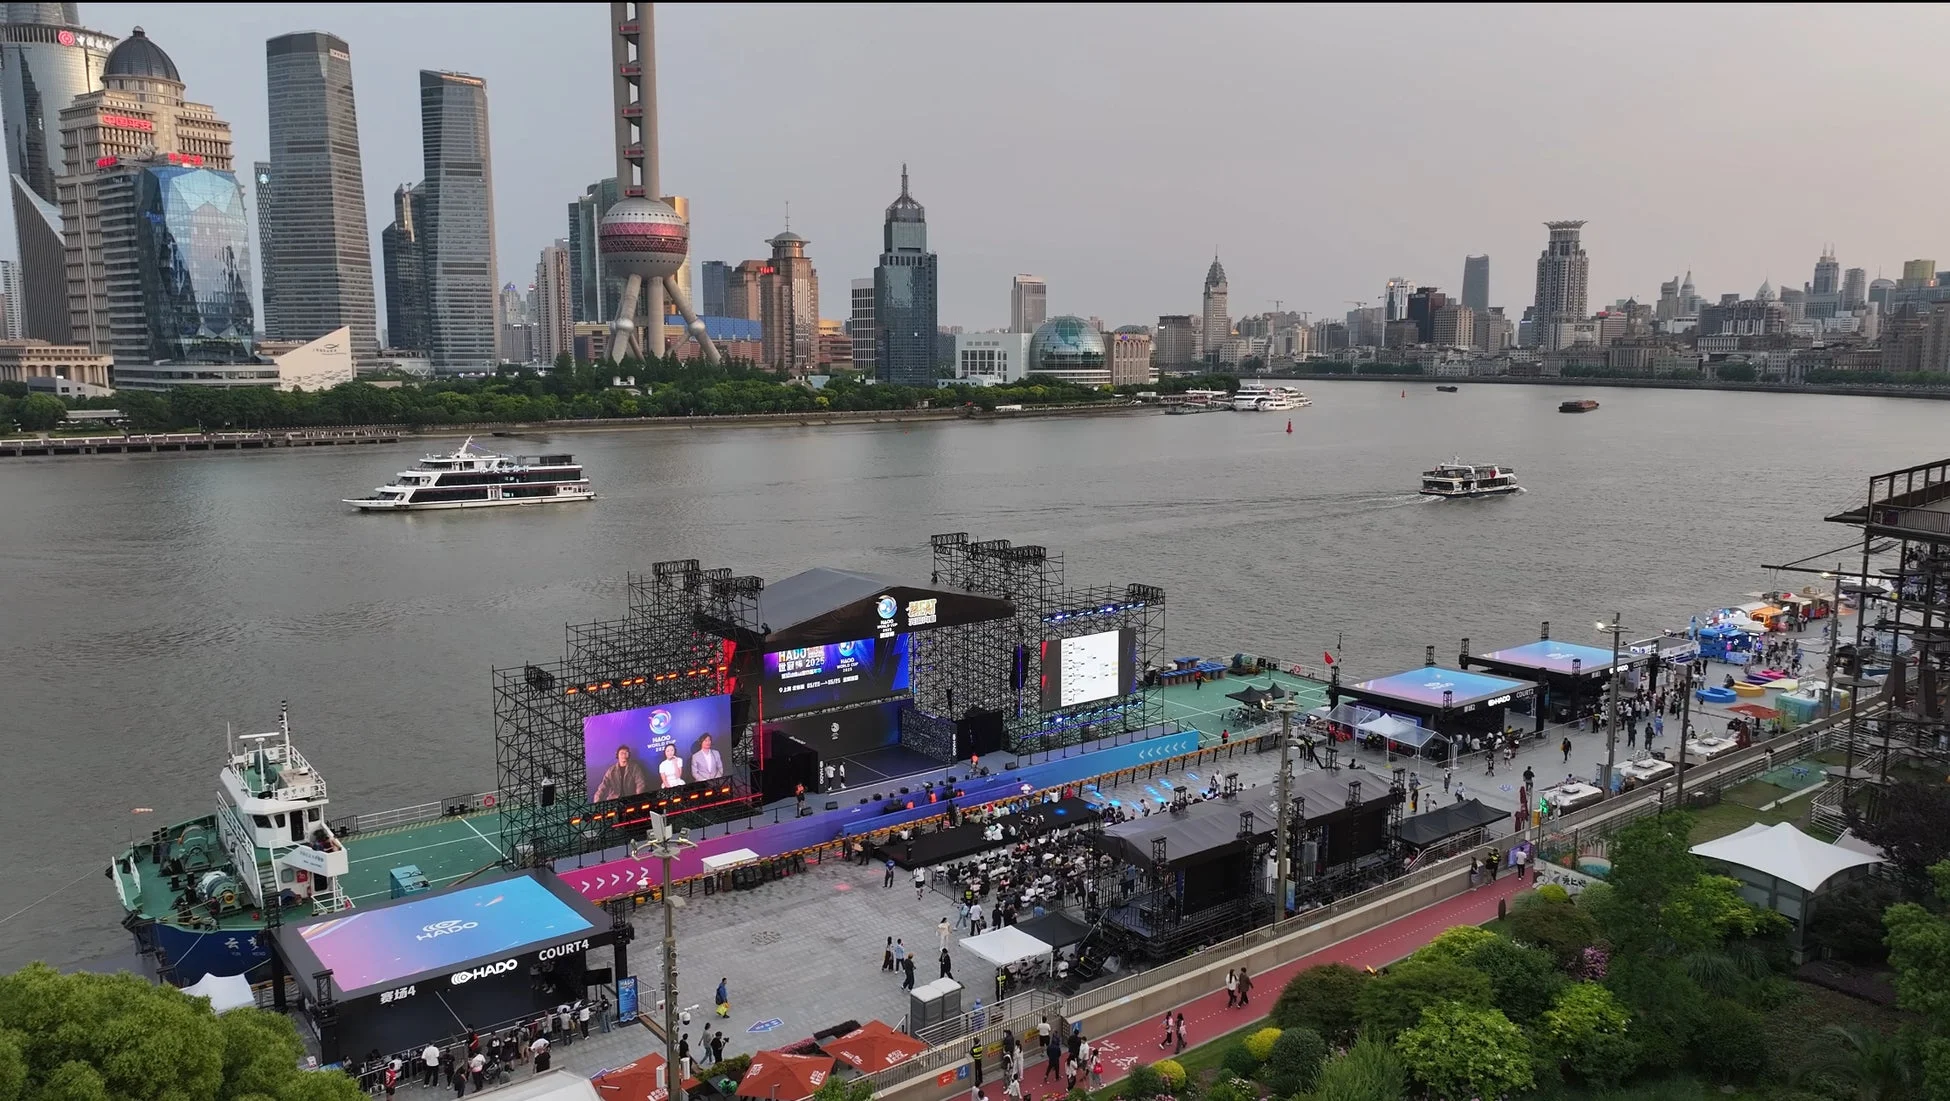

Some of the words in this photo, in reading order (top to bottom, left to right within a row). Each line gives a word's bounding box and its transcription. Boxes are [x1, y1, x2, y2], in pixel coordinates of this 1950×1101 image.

[805, 656, 826, 668] 2025
[416, 920, 479, 941] HADO
[379, 984, 417, 1005] 赛场4
[473, 959, 518, 980] HADO
[538, 939, 590, 962] COURT4
[959, 1065, 967, 1078] 4
